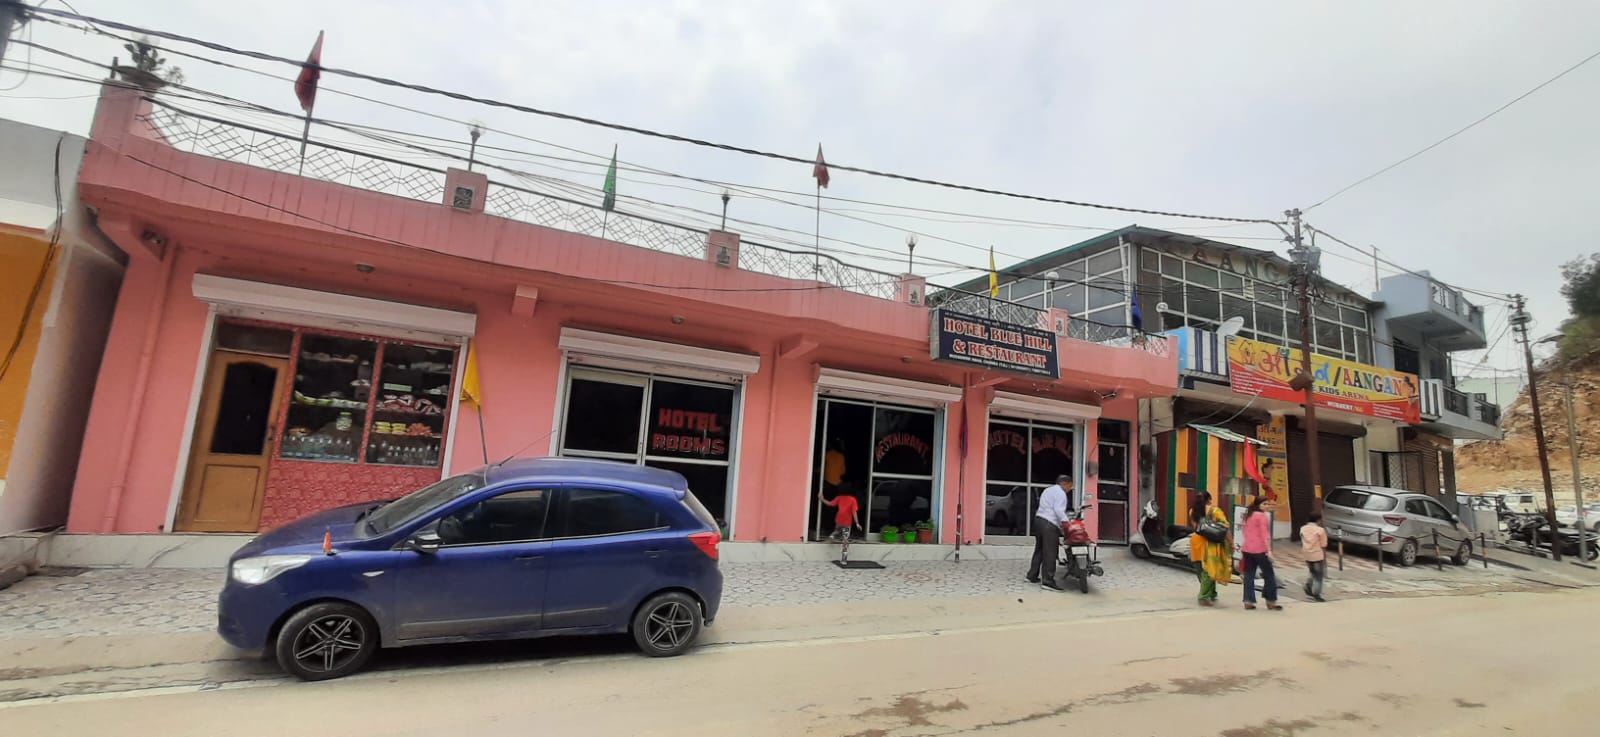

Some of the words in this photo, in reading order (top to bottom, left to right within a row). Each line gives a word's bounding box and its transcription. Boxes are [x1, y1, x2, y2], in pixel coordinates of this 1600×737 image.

[944, 317, 988, 339] HOTEL
[990, 327, 1023, 346] BLUE
[1024, 334, 1053, 352] HILL
[953, 338, 966, 353] &
[968, 341, 1046, 368] RESTAURANT
[1319, 385, 1340, 396] KIDS
[1341, 389, 1369, 401] ARENA
[658, 407, 721, 433] HOTEL
[652, 432, 726, 456] ROOMS
[875, 431, 930, 463] RESTAURANT
